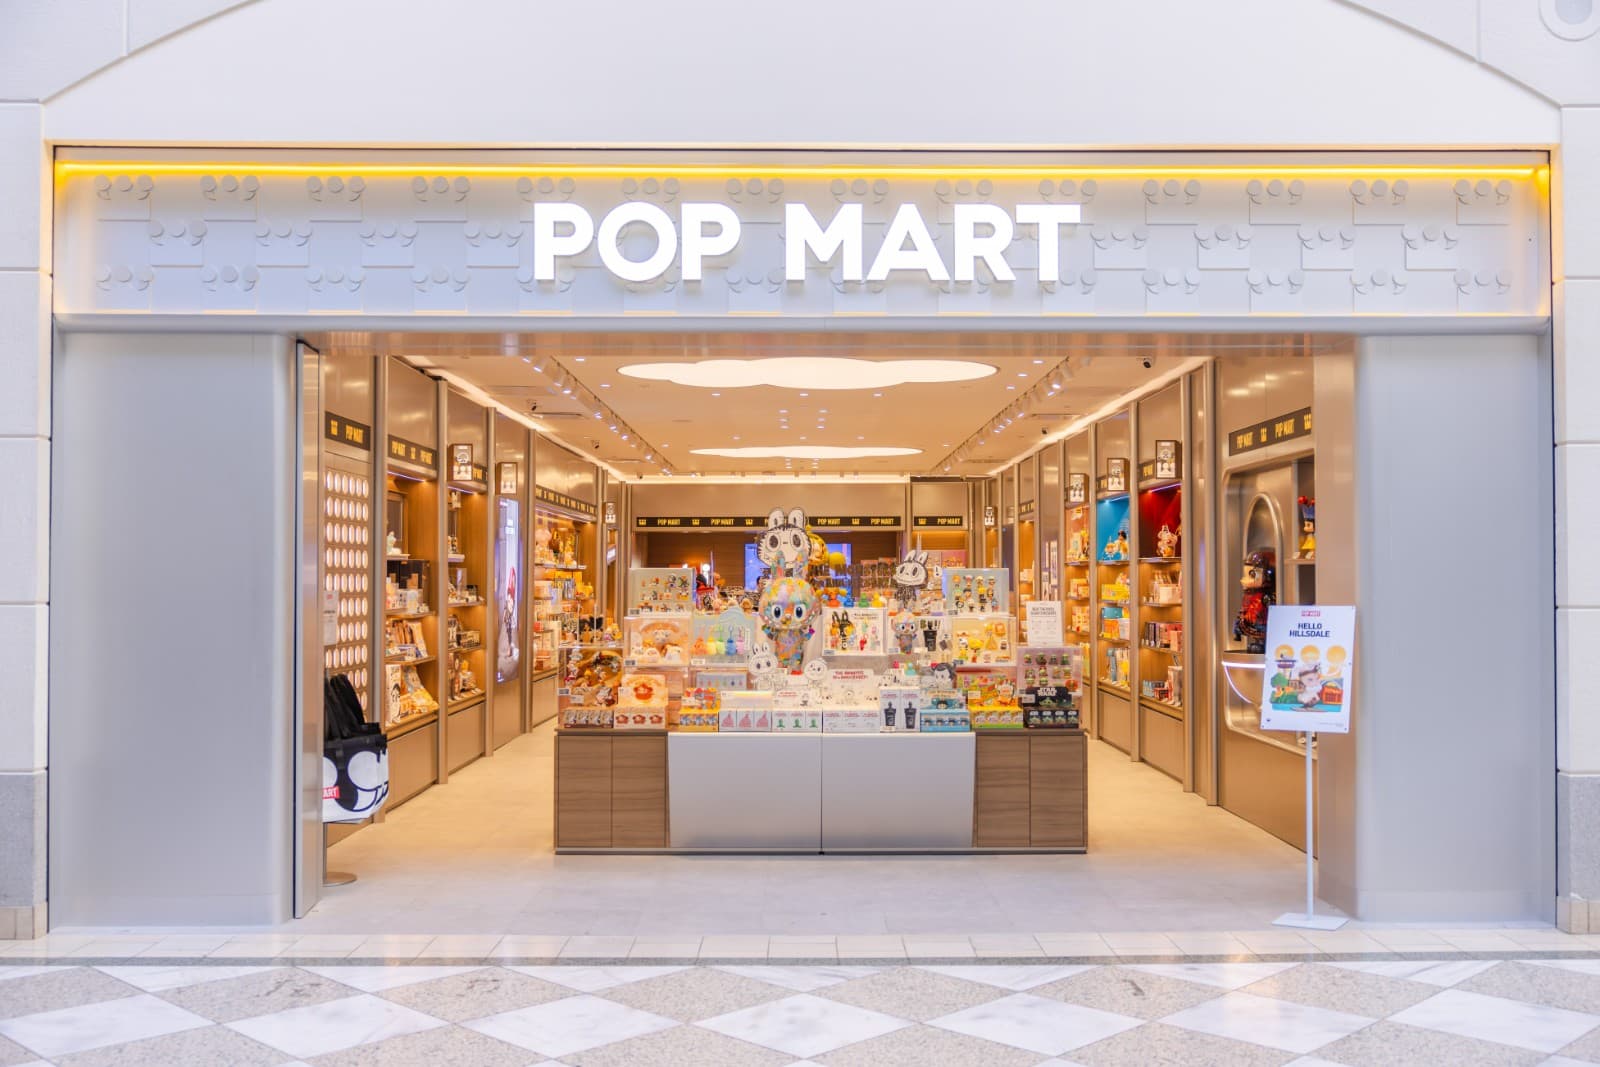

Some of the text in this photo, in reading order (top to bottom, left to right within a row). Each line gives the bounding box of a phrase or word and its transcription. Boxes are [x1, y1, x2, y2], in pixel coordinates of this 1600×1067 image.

[533, 201, 1081, 282] POP MART
[657, 518, 680, 526] POP MART
[710, 518, 734, 526] POP MART
[1298, 622, 1322, 630] HELLO
[322, 787, 337, 799] ART
